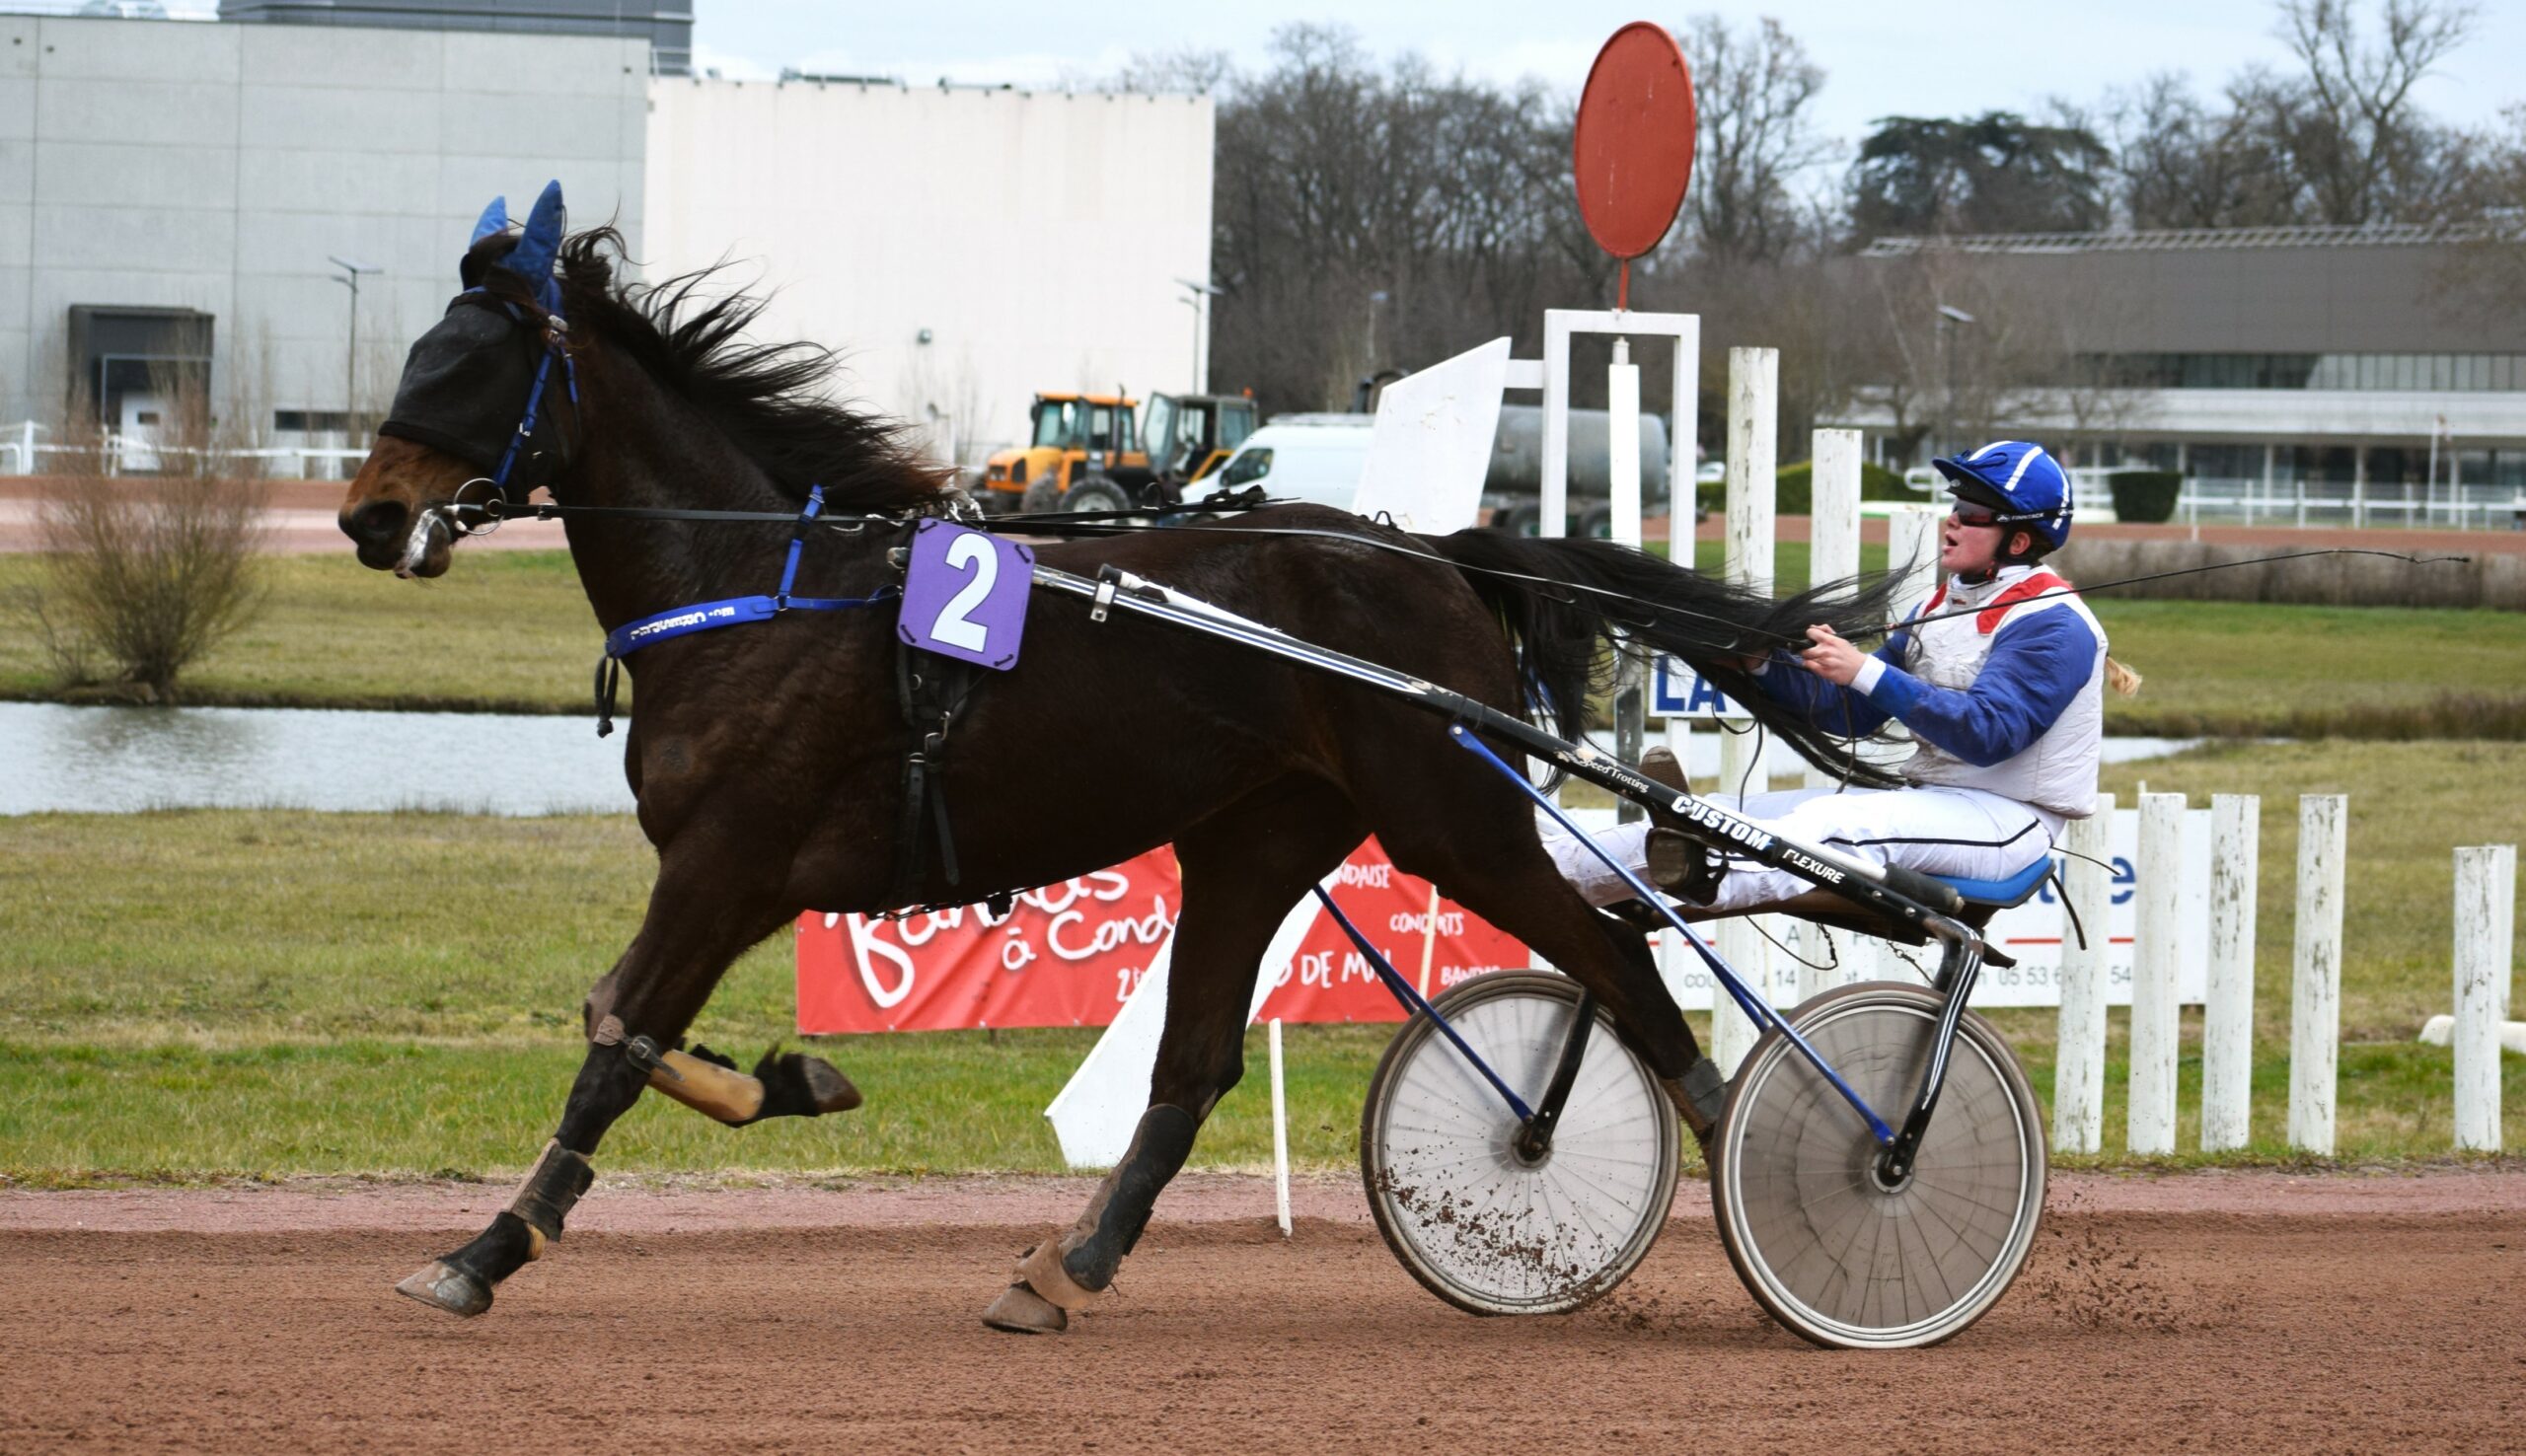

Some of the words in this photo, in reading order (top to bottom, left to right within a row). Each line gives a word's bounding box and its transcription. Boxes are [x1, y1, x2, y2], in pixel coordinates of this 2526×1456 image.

[929, 532, 999, 653] 2
[1655, 654, 1728, 712] LA
[1608, 763, 1651, 793] Trotting
[1672, 796, 1772, 851] CUSTOM
[1336, 862, 1391, 889] NDAISE
[1782, 848, 1846, 884] FLEXURE
[1047, 893, 1181, 960] Cond
[1389, 911, 1464, 936] CONCRTS
[1300, 950, 1334, 988] DE
[2026, 965, 2048, 984] 53
[2110, 963, 2132, 983] 54
